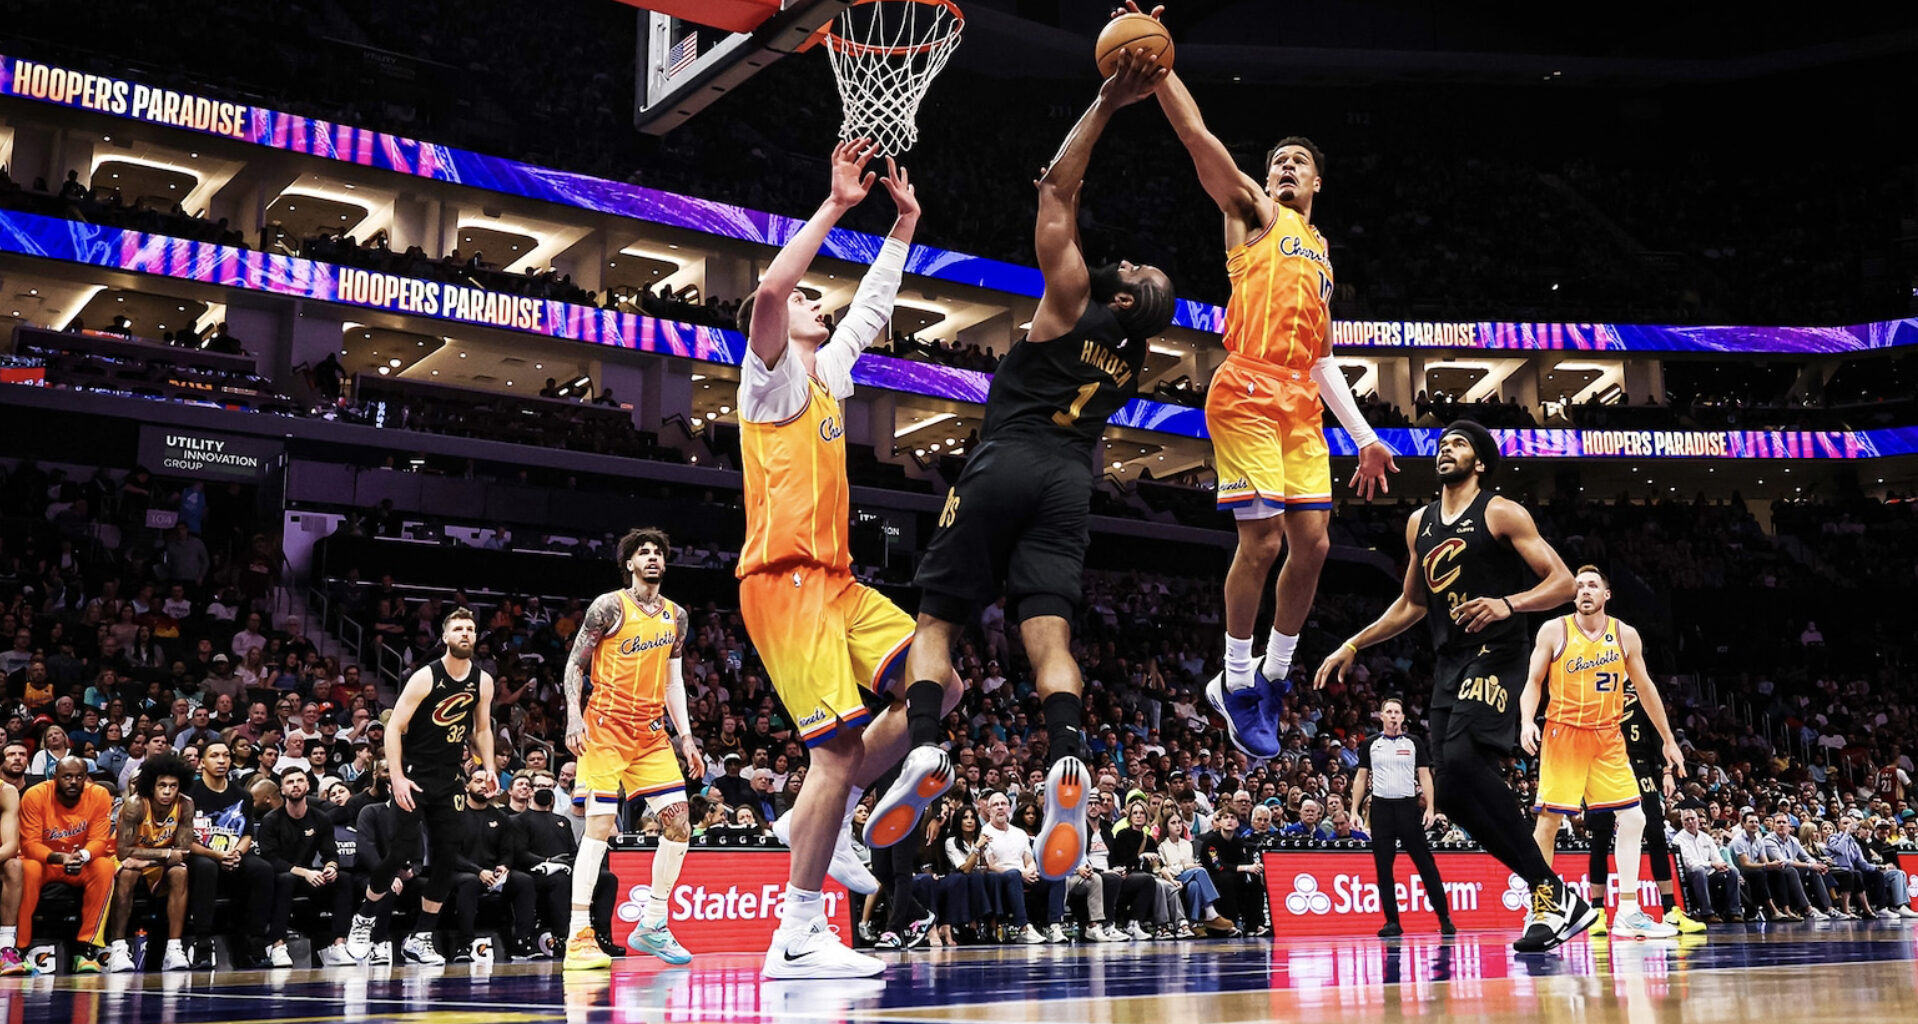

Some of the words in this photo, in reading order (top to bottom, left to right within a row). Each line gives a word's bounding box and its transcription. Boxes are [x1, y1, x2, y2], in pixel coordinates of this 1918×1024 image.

[12, 59, 129, 114] HOOPERS
[131, 84, 247, 137] PARADISE
[337, 267, 440, 315] HOOPERS
[442, 284, 544, 331] PARADISE
[1332, 321, 1402, 346] HOOPERS
[1404, 321, 1477, 347] PARADISE
[1080, 339, 1133, 388] HARDEN
[1051, 381, 1100, 427] 1
[166, 435, 224, 452] UTILITY
[1581, 430, 1652, 456] HOOPERS
[1653, 430, 1728, 456] PARADISE
[163, 458, 203, 470] GROUP
[183, 449, 257, 467] INNOVATION
[1566, 649, 1620, 674] Charlotte
[1458, 675, 1508, 713] CAVS
[1596, 672, 1619, 692] 21
[446, 724, 466, 743] 32
[1630, 724, 1640, 742] 5
